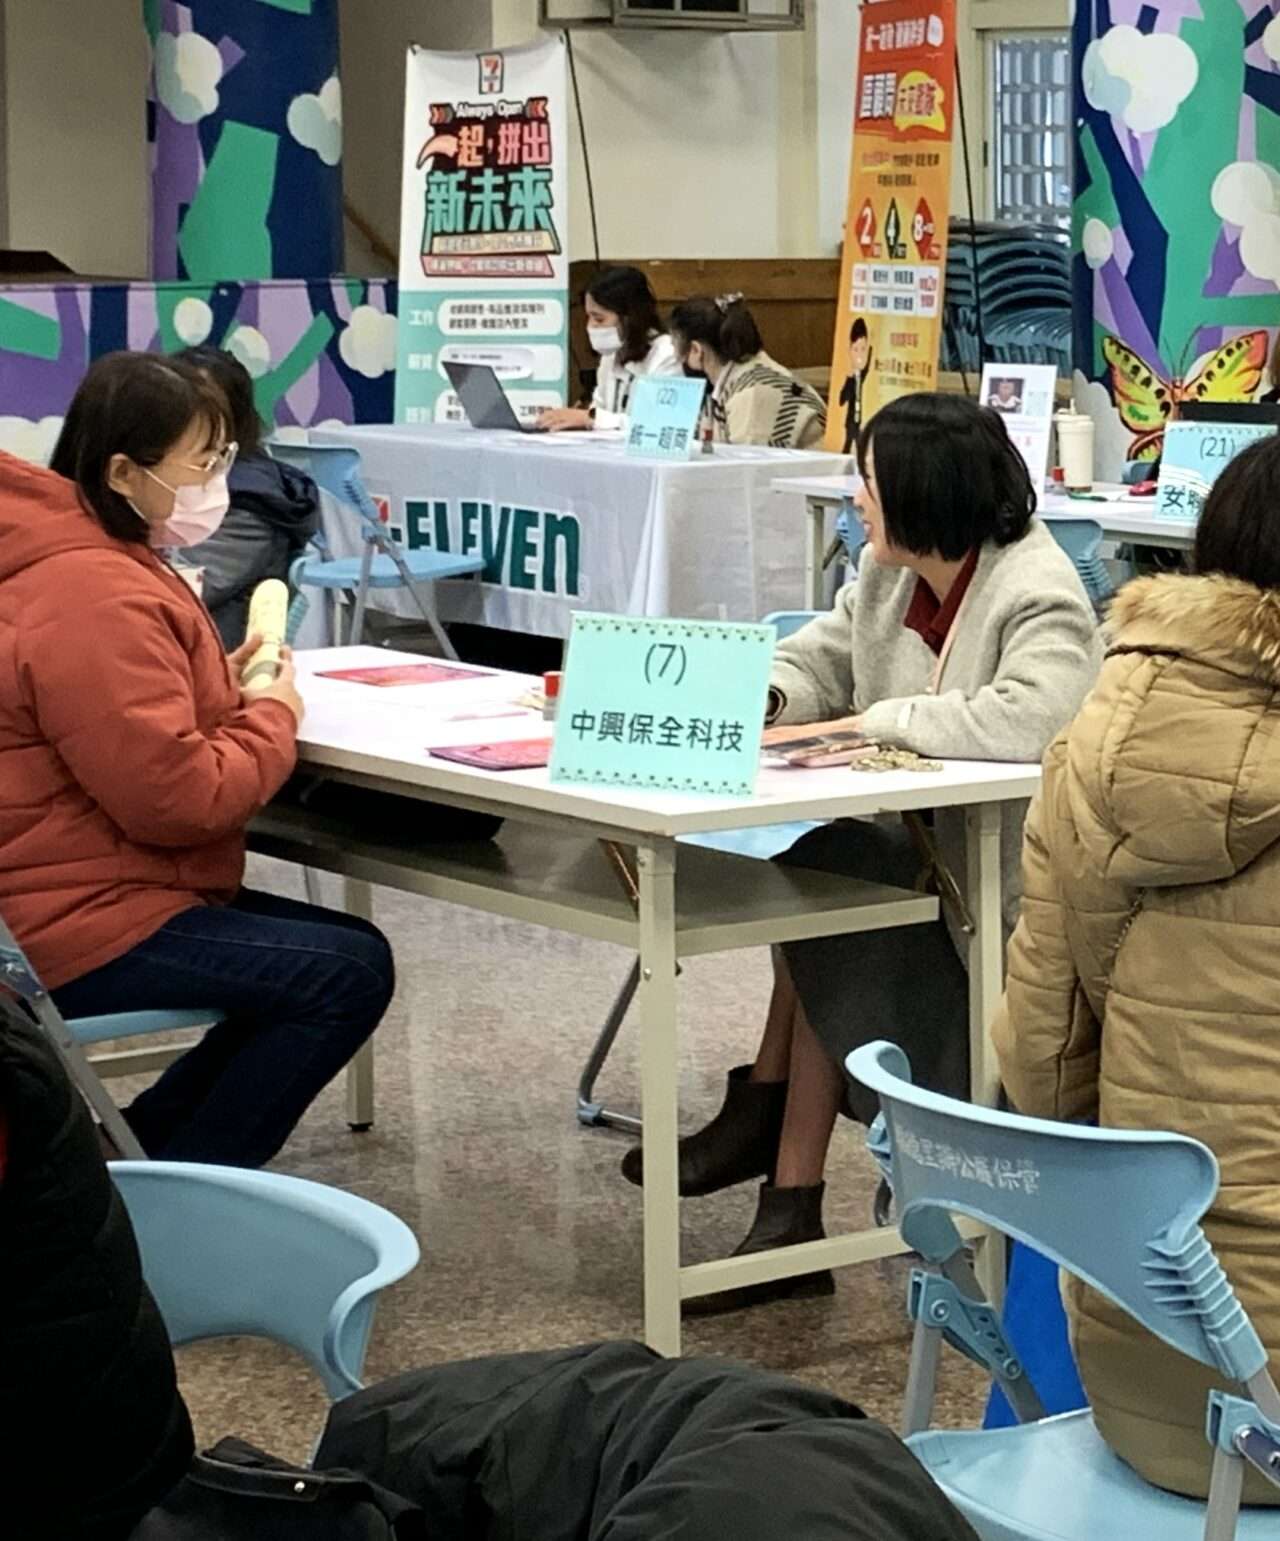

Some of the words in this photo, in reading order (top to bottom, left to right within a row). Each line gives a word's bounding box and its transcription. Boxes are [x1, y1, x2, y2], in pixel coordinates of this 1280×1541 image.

[425, 168, 552, 232] 新未來
[656, 387, 679, 408] (22)
[1200, 436, 1236, 461] (21)
[644, 643, 688, 686] (7)
[570, 710, 745, 753] 中興保全科技
